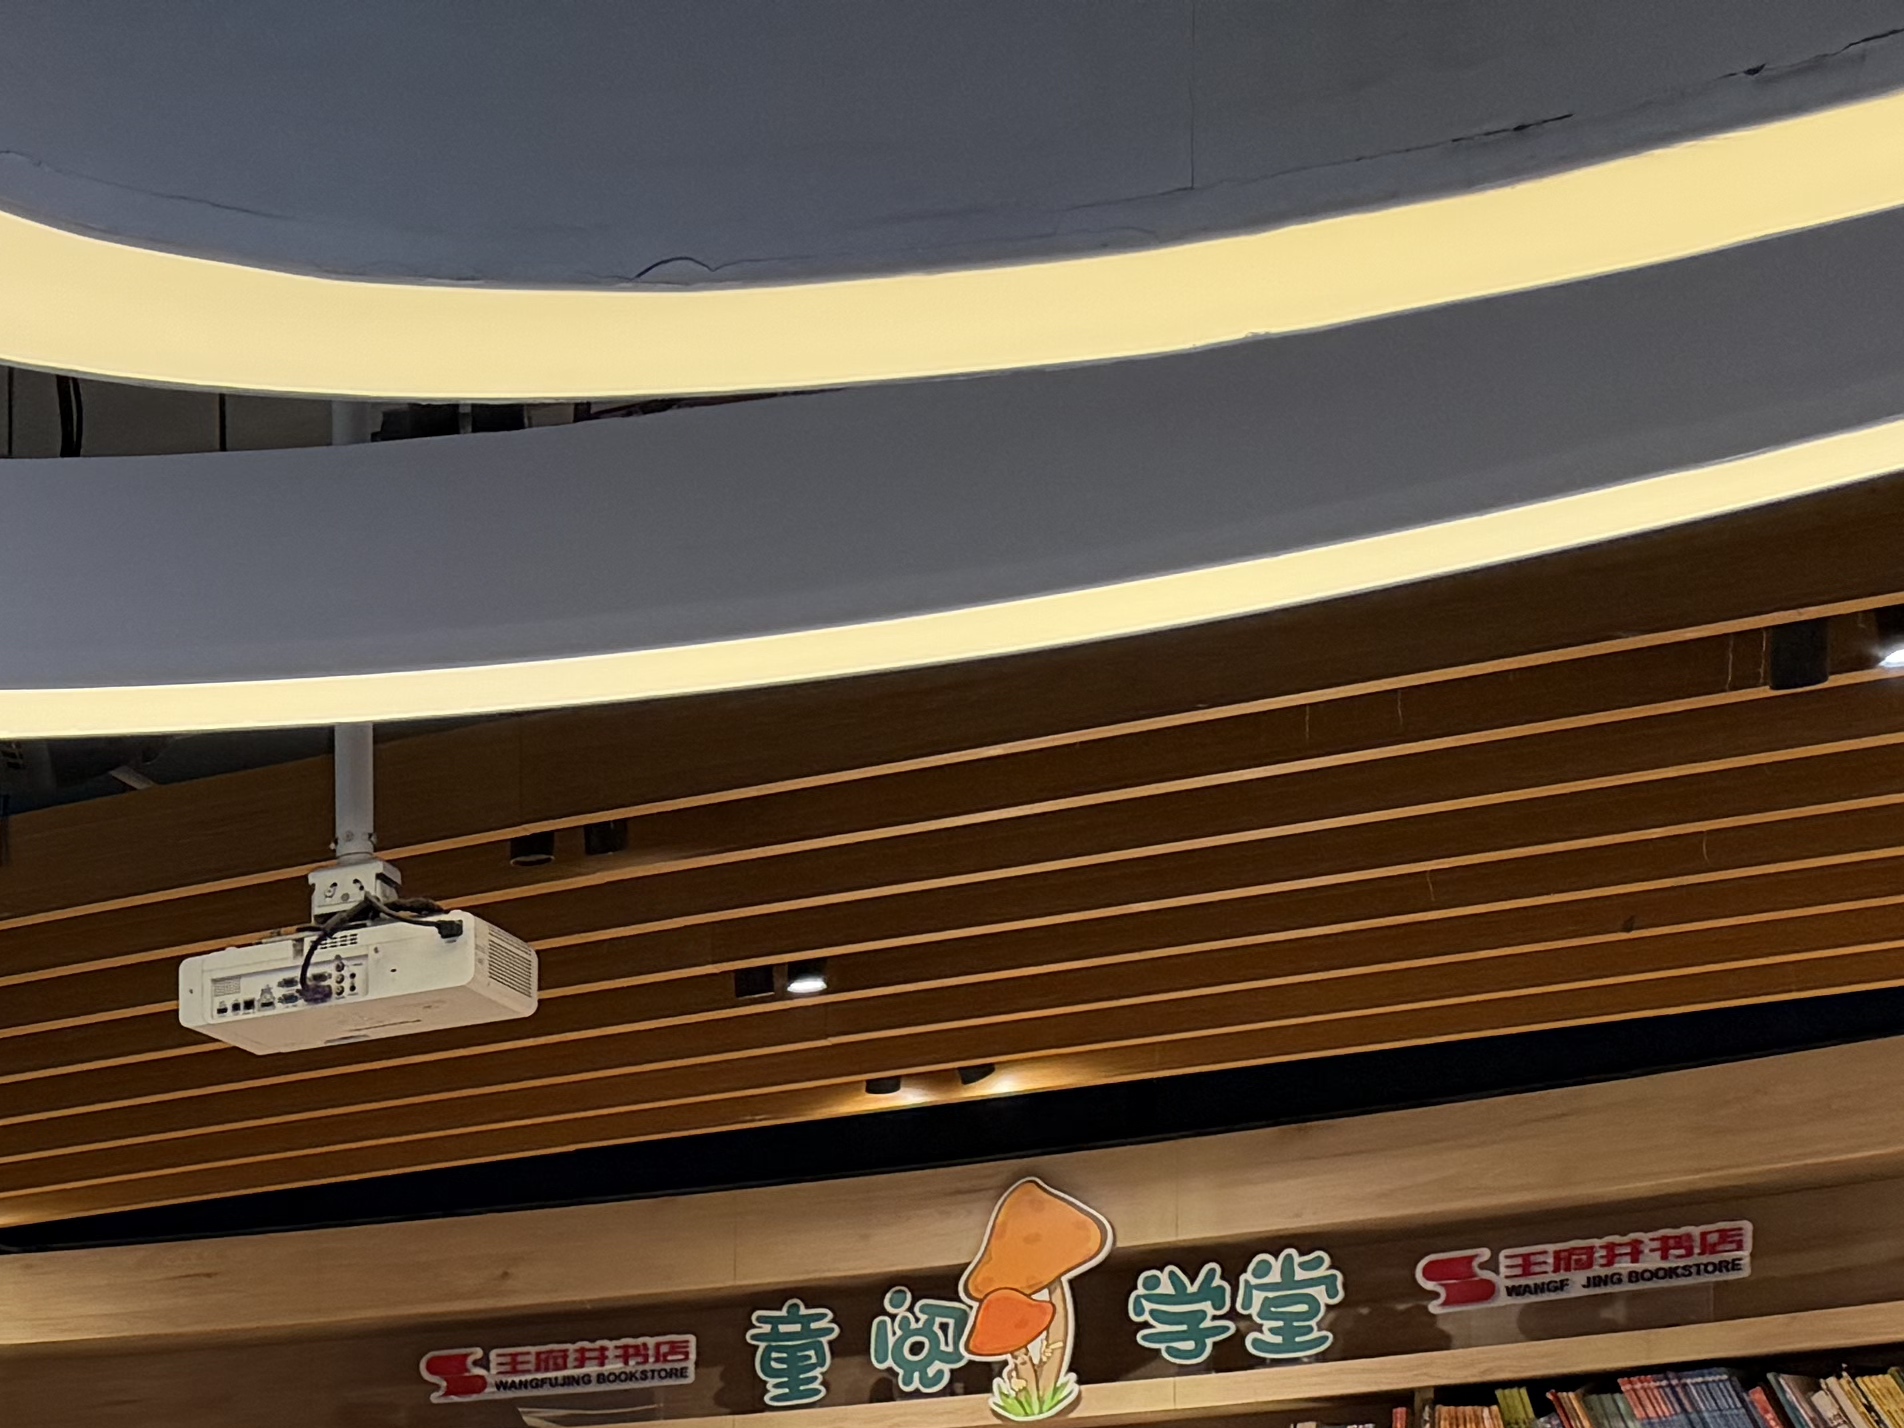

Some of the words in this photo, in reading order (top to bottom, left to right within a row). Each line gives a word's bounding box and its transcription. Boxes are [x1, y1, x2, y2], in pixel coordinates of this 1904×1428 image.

[1505, 1227, 1745, 1279] 王府井书店
[1628, 1258, 1744, 1285] BOOKSTORE
[495, 1339, 691, 1375] 王府井书店
[493, 1372, 593, 1392] WANGFUJING
[597, 1366, 690, 1385] BOOKSTORE
